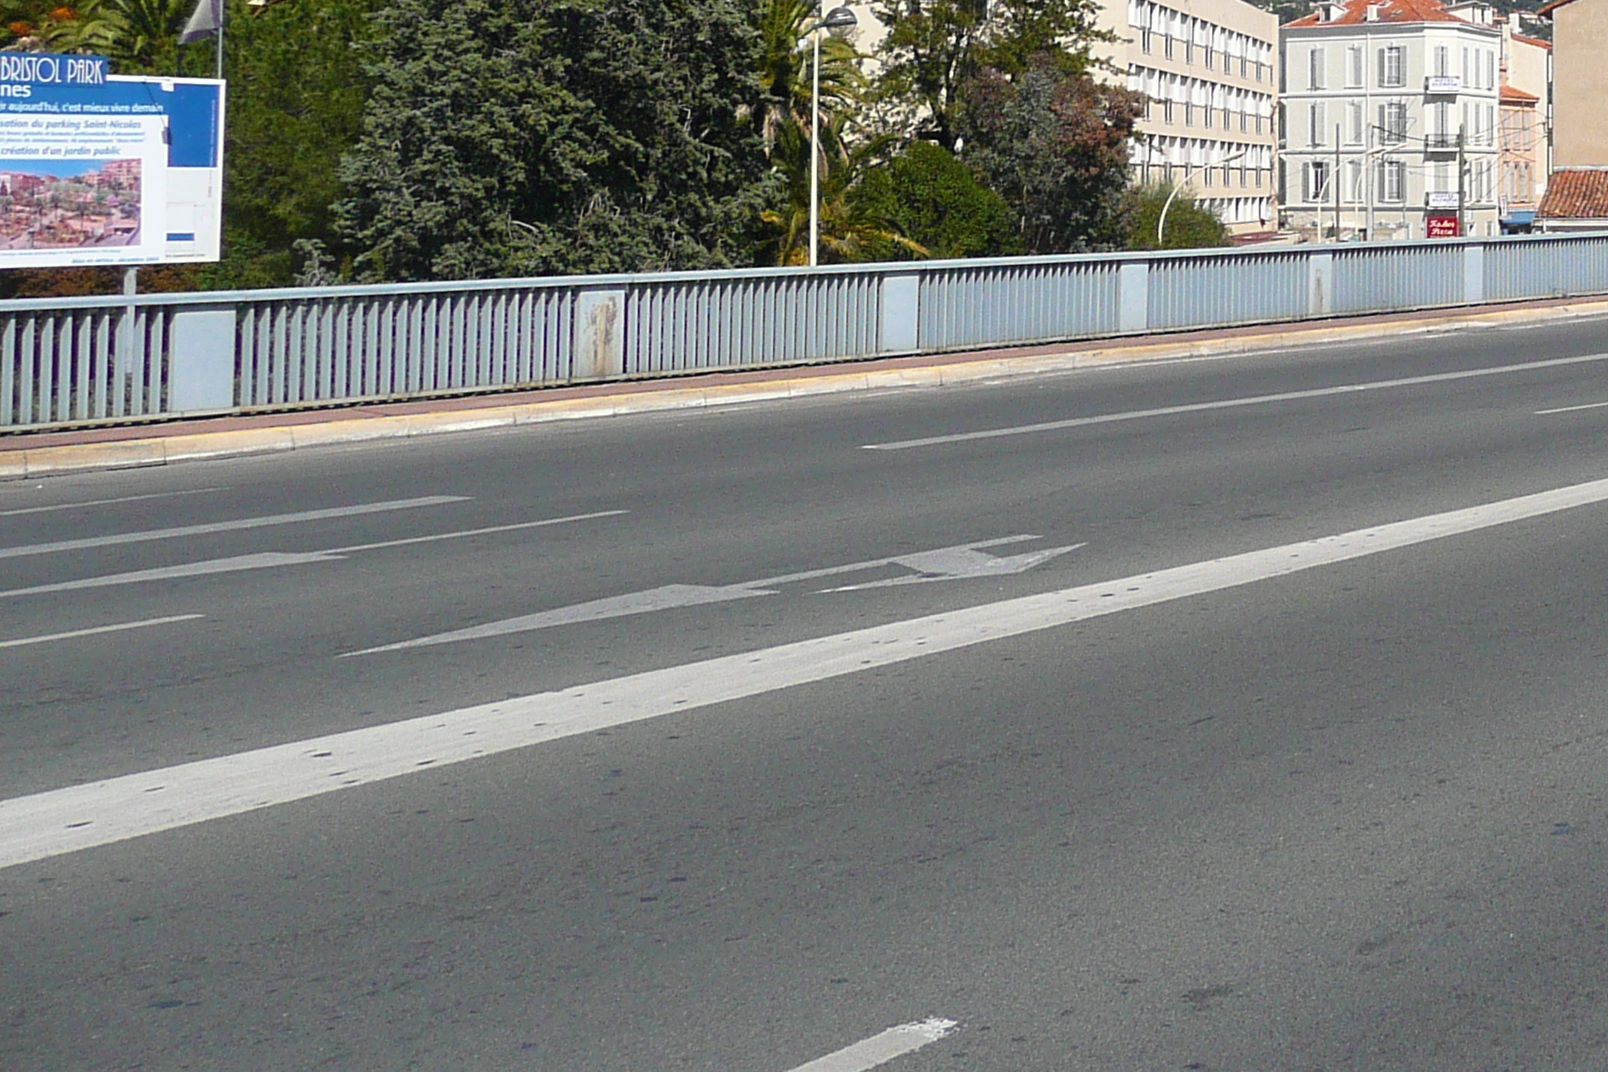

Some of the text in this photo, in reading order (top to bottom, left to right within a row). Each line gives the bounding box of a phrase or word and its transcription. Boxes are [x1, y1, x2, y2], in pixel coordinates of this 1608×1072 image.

[0, 55, 104, 84] BRISTOL PARK
[8, 101, 59, 113] aujourd'hui,
[131, 103, 163, 113] demain
[45, 119, 82, 131] parking
